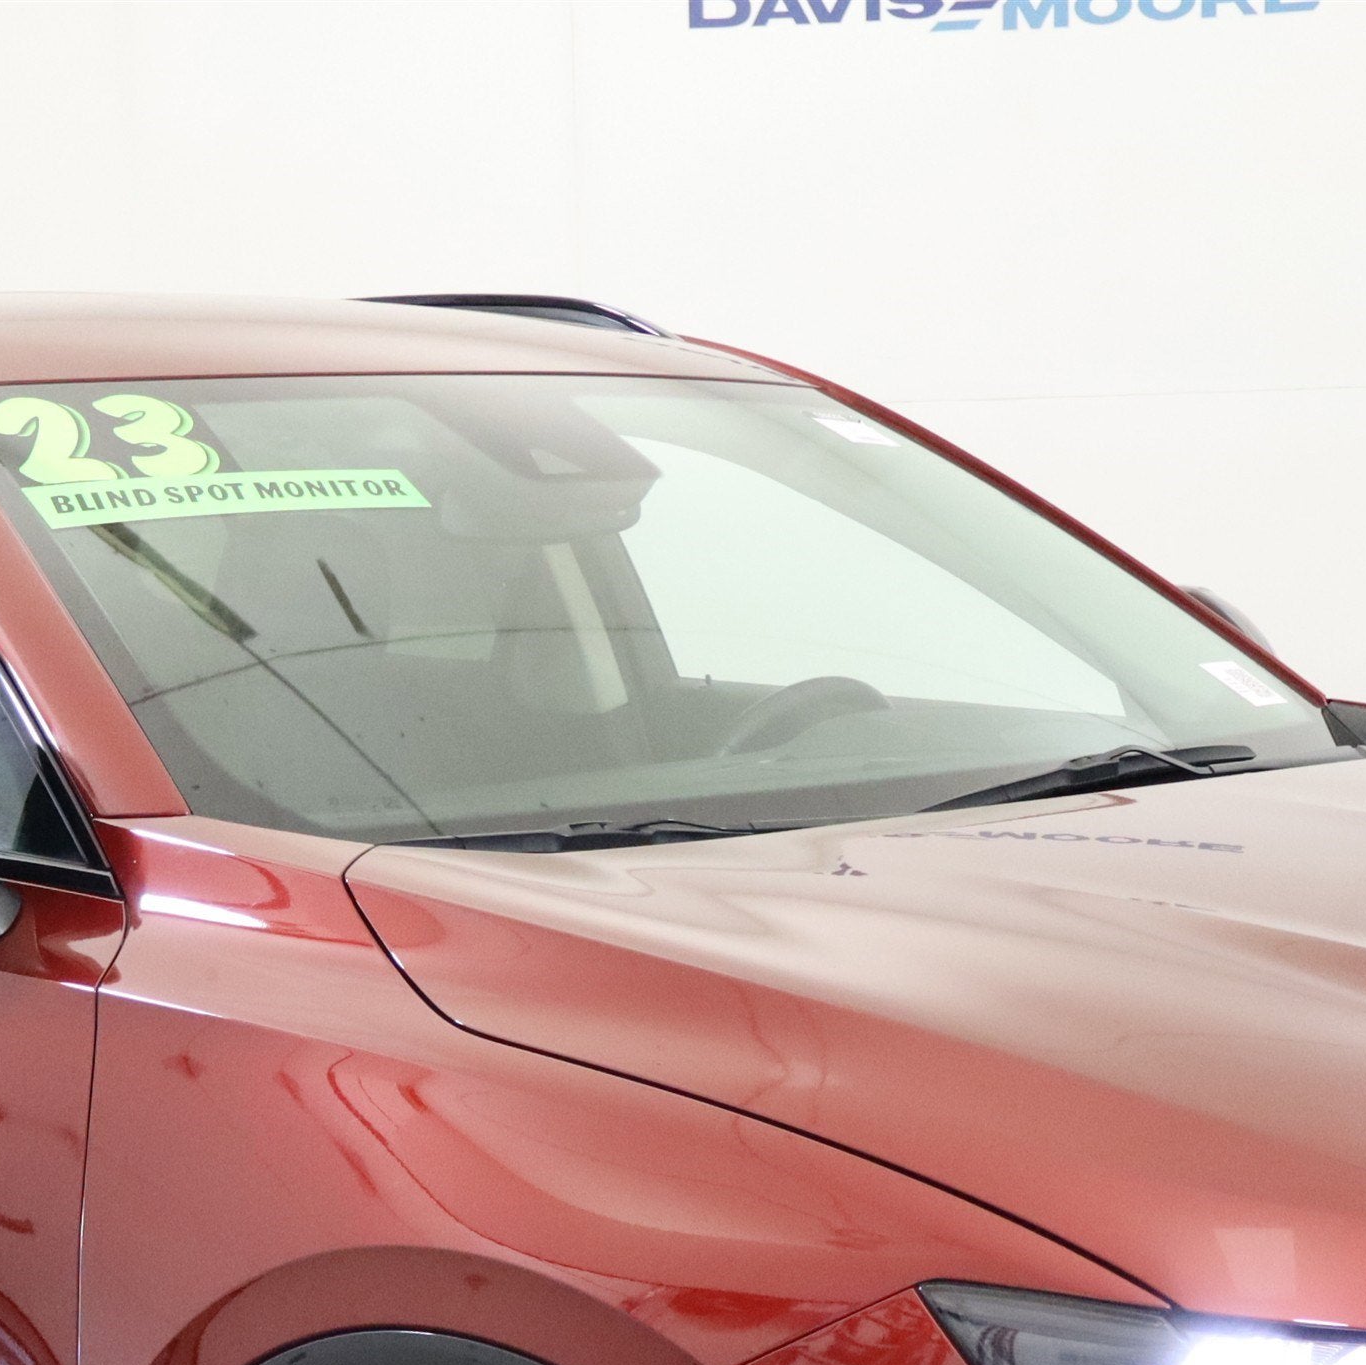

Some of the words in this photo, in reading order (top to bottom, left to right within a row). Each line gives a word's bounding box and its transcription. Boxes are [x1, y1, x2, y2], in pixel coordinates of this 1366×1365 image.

[50, 489, 156, 514] BLIND
[168, 481, 247, 504] SPOT
[255, 479, 407, 500] MONITOR
